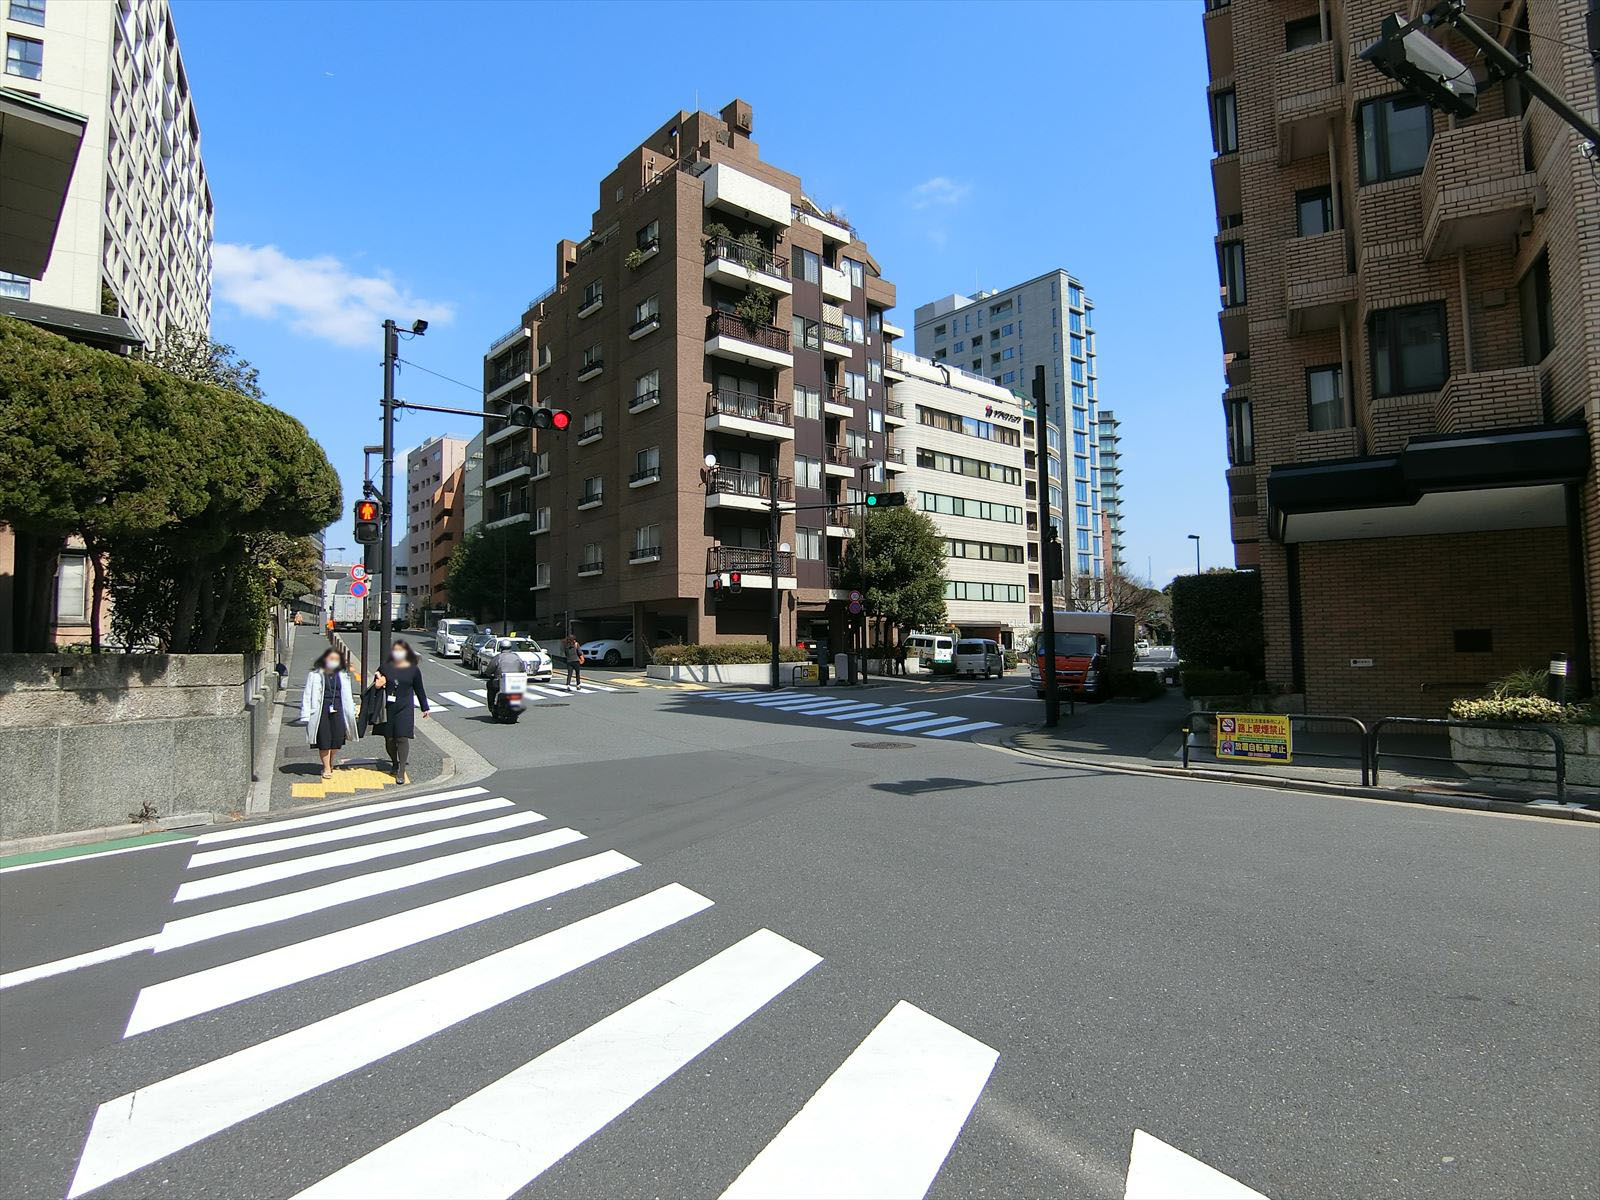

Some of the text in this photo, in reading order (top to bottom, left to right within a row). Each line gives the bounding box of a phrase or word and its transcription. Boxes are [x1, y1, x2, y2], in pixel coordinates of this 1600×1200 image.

[1238, 724, 1286, 736] 路上喫煙禁止
[1235, 742, 1286, 753] 放置自転車禁止
